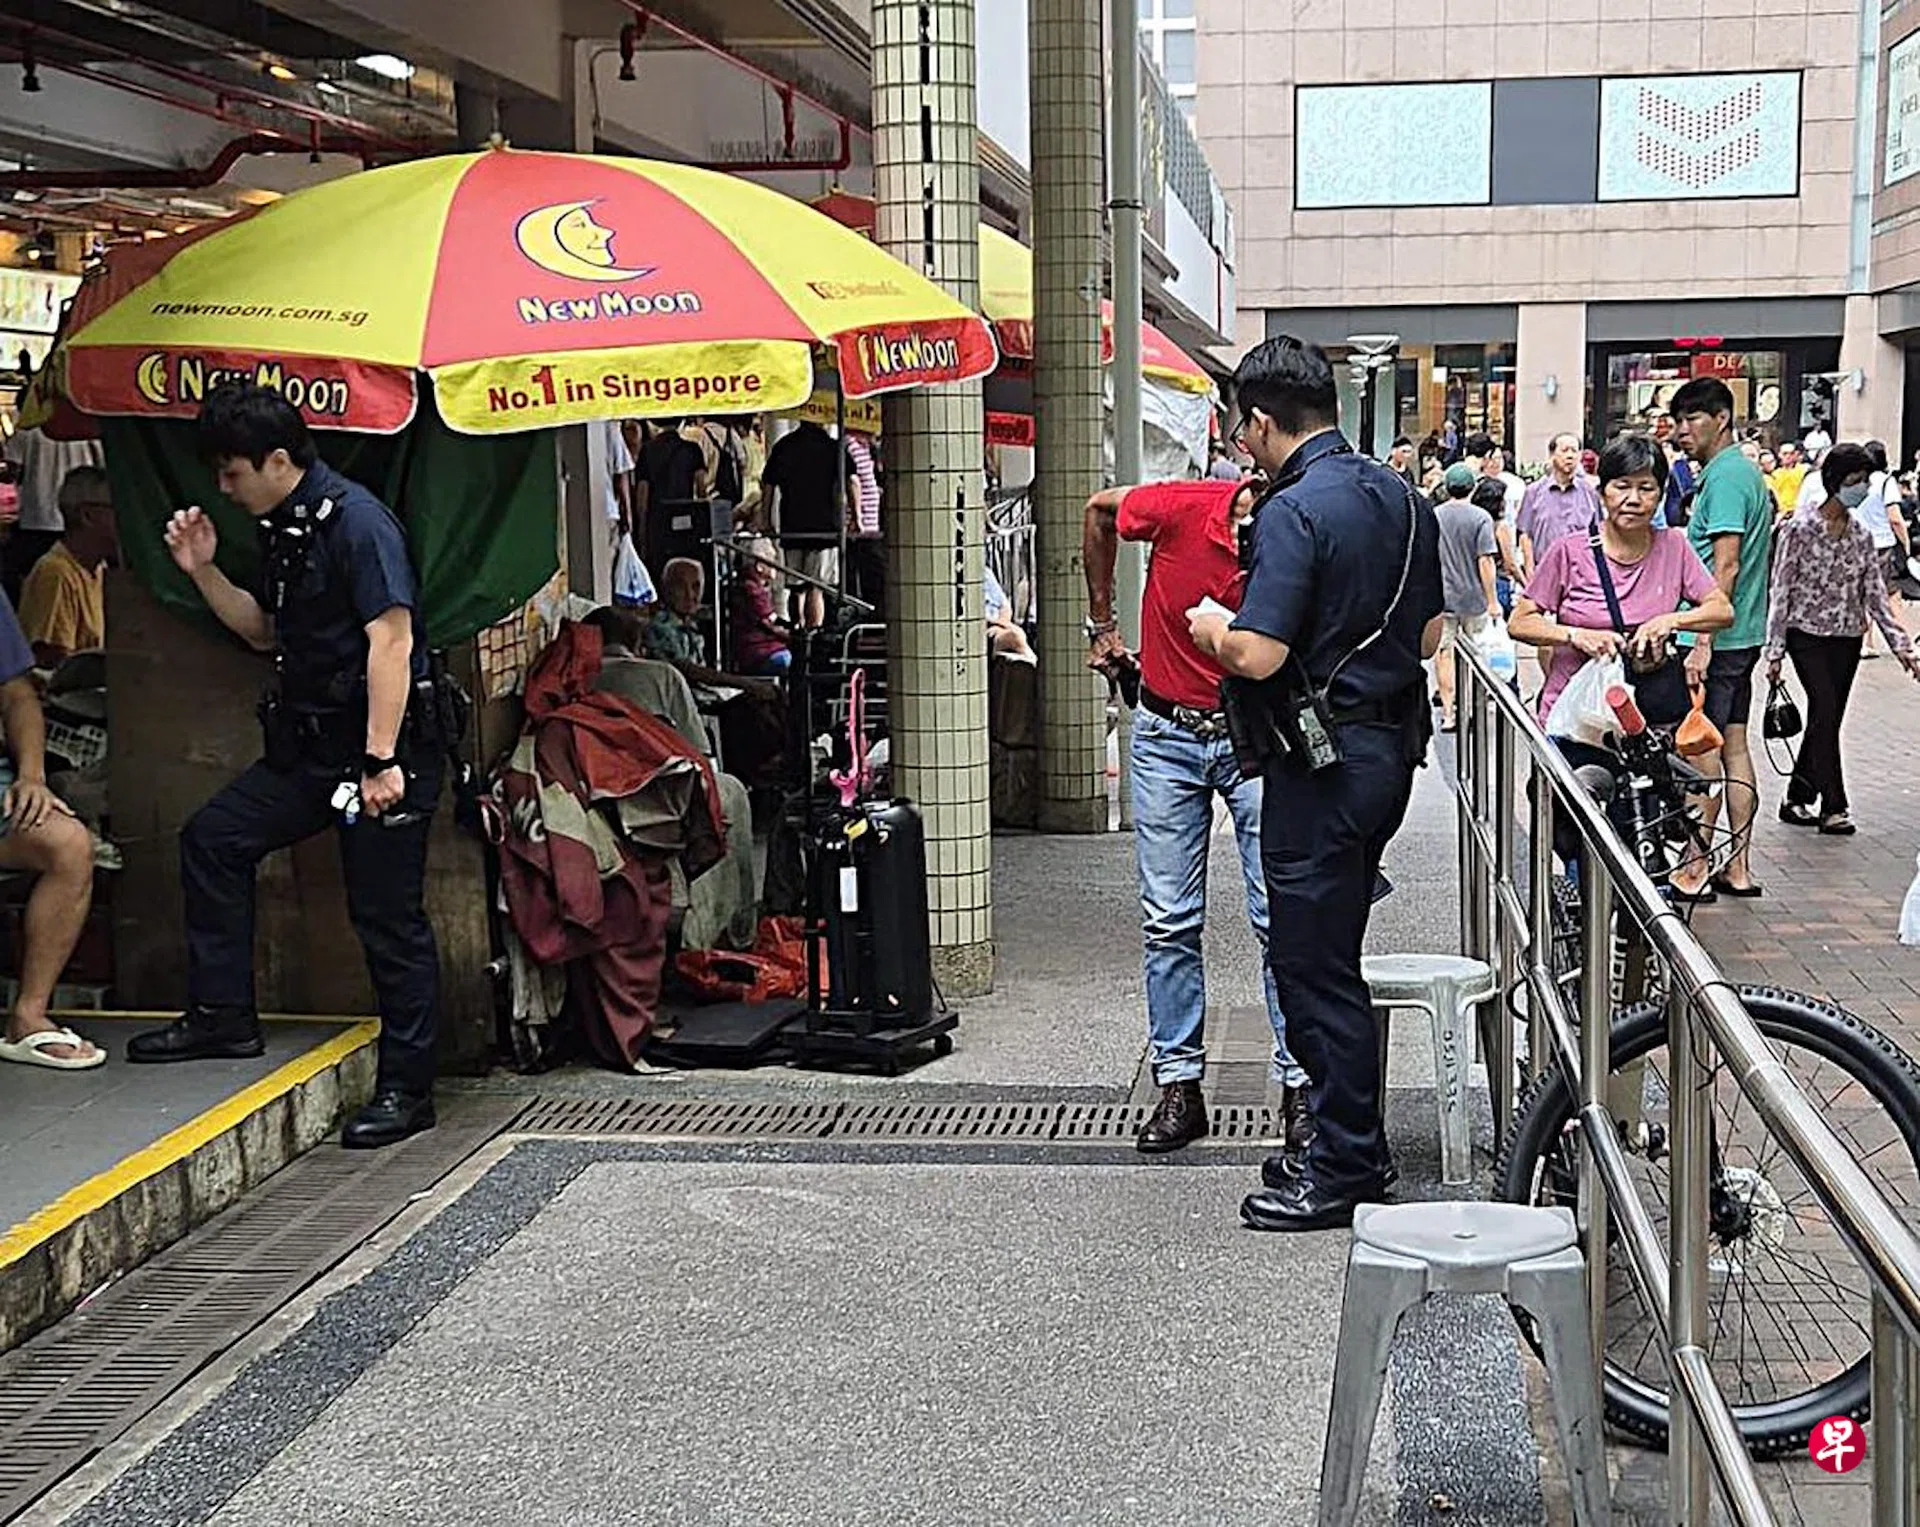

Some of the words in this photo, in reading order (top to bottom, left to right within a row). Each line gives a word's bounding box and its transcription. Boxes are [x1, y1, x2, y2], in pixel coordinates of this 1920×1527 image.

[151, 302, 369, 327] newmoon.com.sg
[565, 379, 595, 402] in
[602, 373, 762, 402] Singapore
